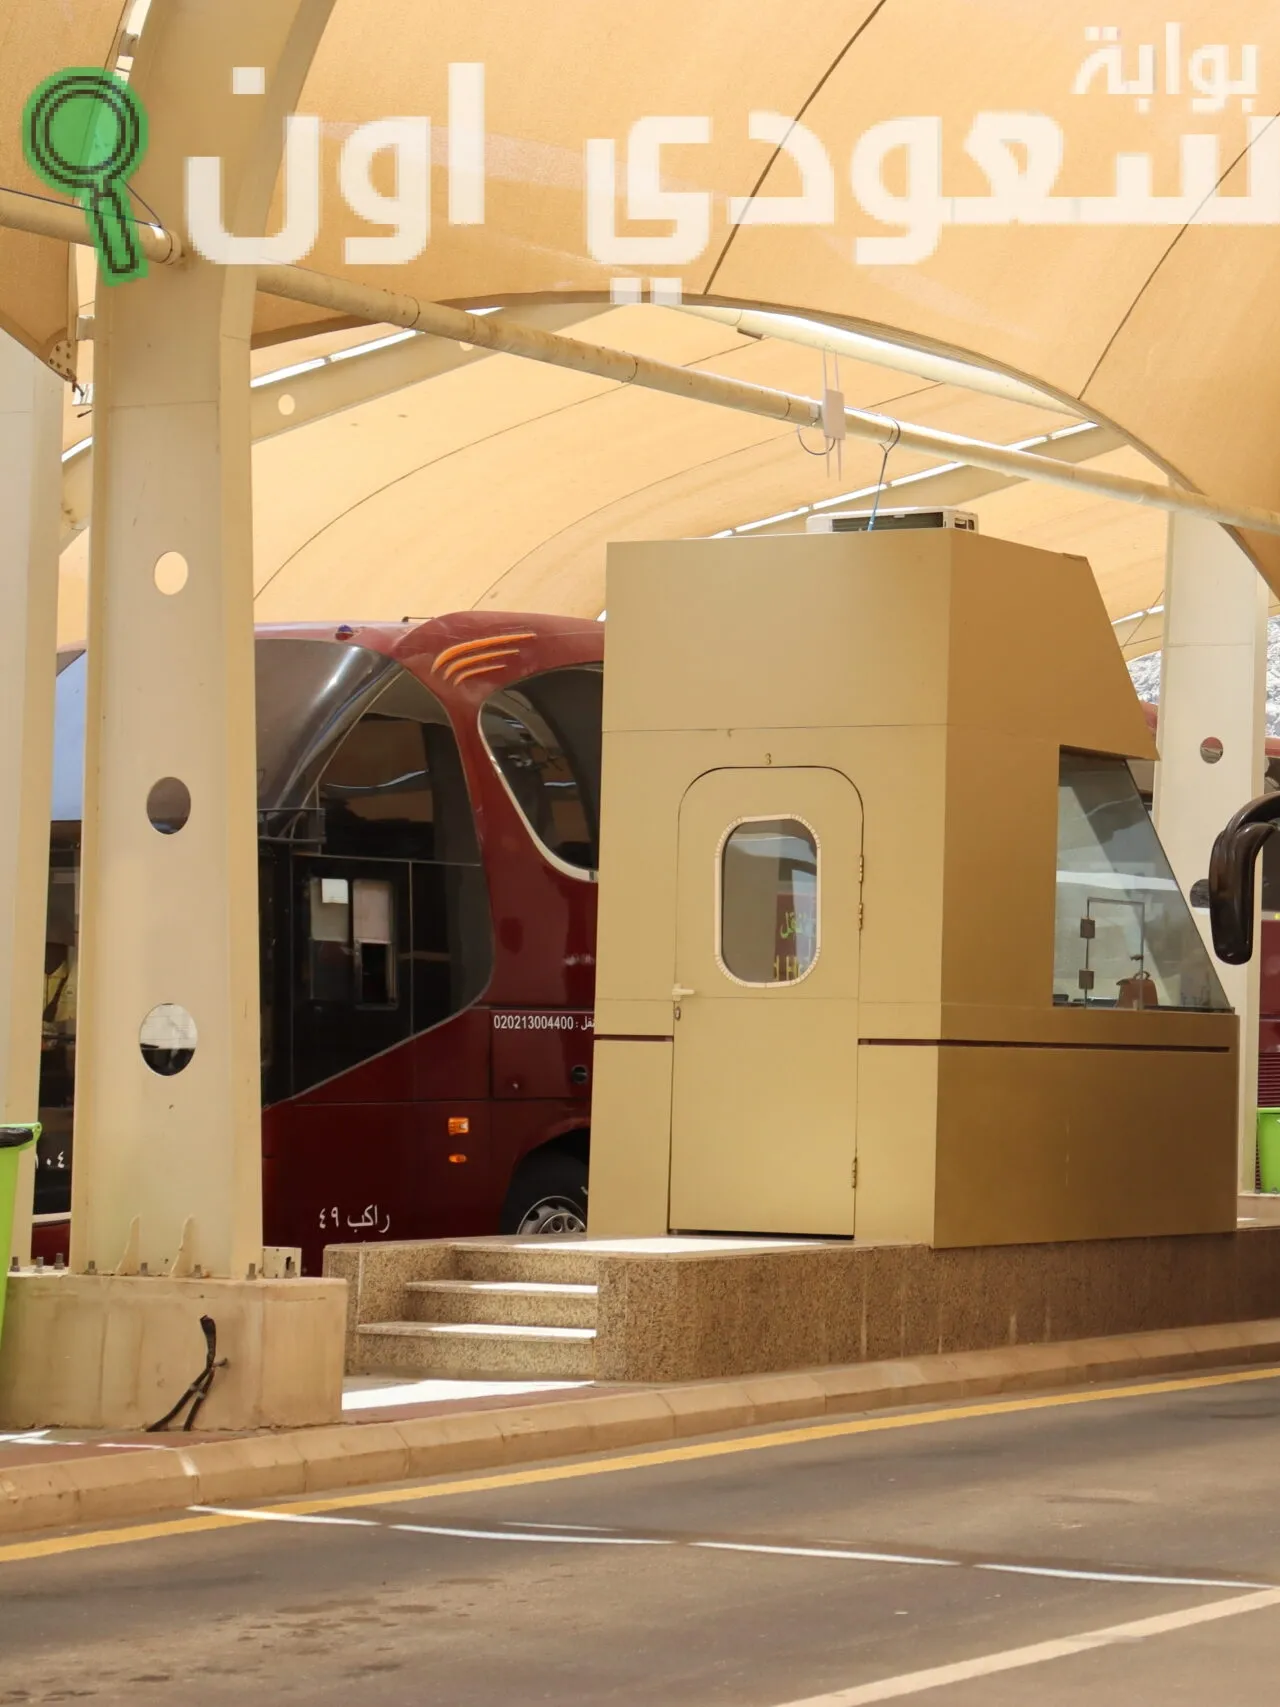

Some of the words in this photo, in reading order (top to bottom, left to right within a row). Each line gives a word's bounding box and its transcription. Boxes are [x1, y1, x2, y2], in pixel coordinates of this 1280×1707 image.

[764, 752, 772, 765] 3
[493, 1014, 574, 1030] 020213004400
[319, 1206, 340, 1229] ٤٩
[347, 1203, 391, 1233] راكب
